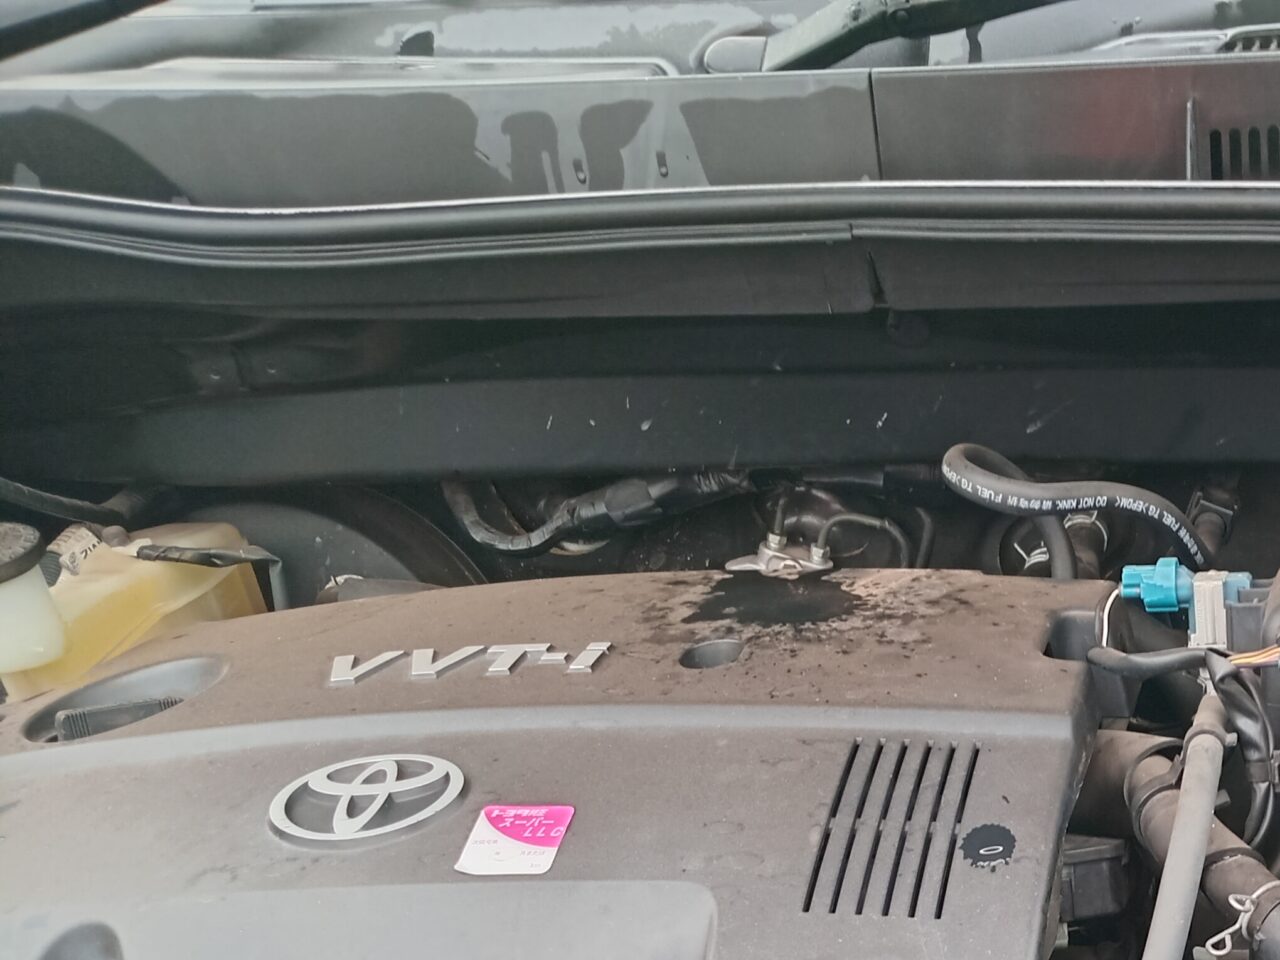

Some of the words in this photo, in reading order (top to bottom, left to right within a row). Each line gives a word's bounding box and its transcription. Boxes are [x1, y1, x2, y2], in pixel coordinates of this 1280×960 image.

[976, 485, 1002, 503] FUEL
[1078, 496, 1095, 509] NOT
[1095, 495, 1107, 507] DO
[1162, 510, 1181, 532] FUEL
[498, 817, 555, 828] スーパー
[522, 827, 564, 837] LLC
